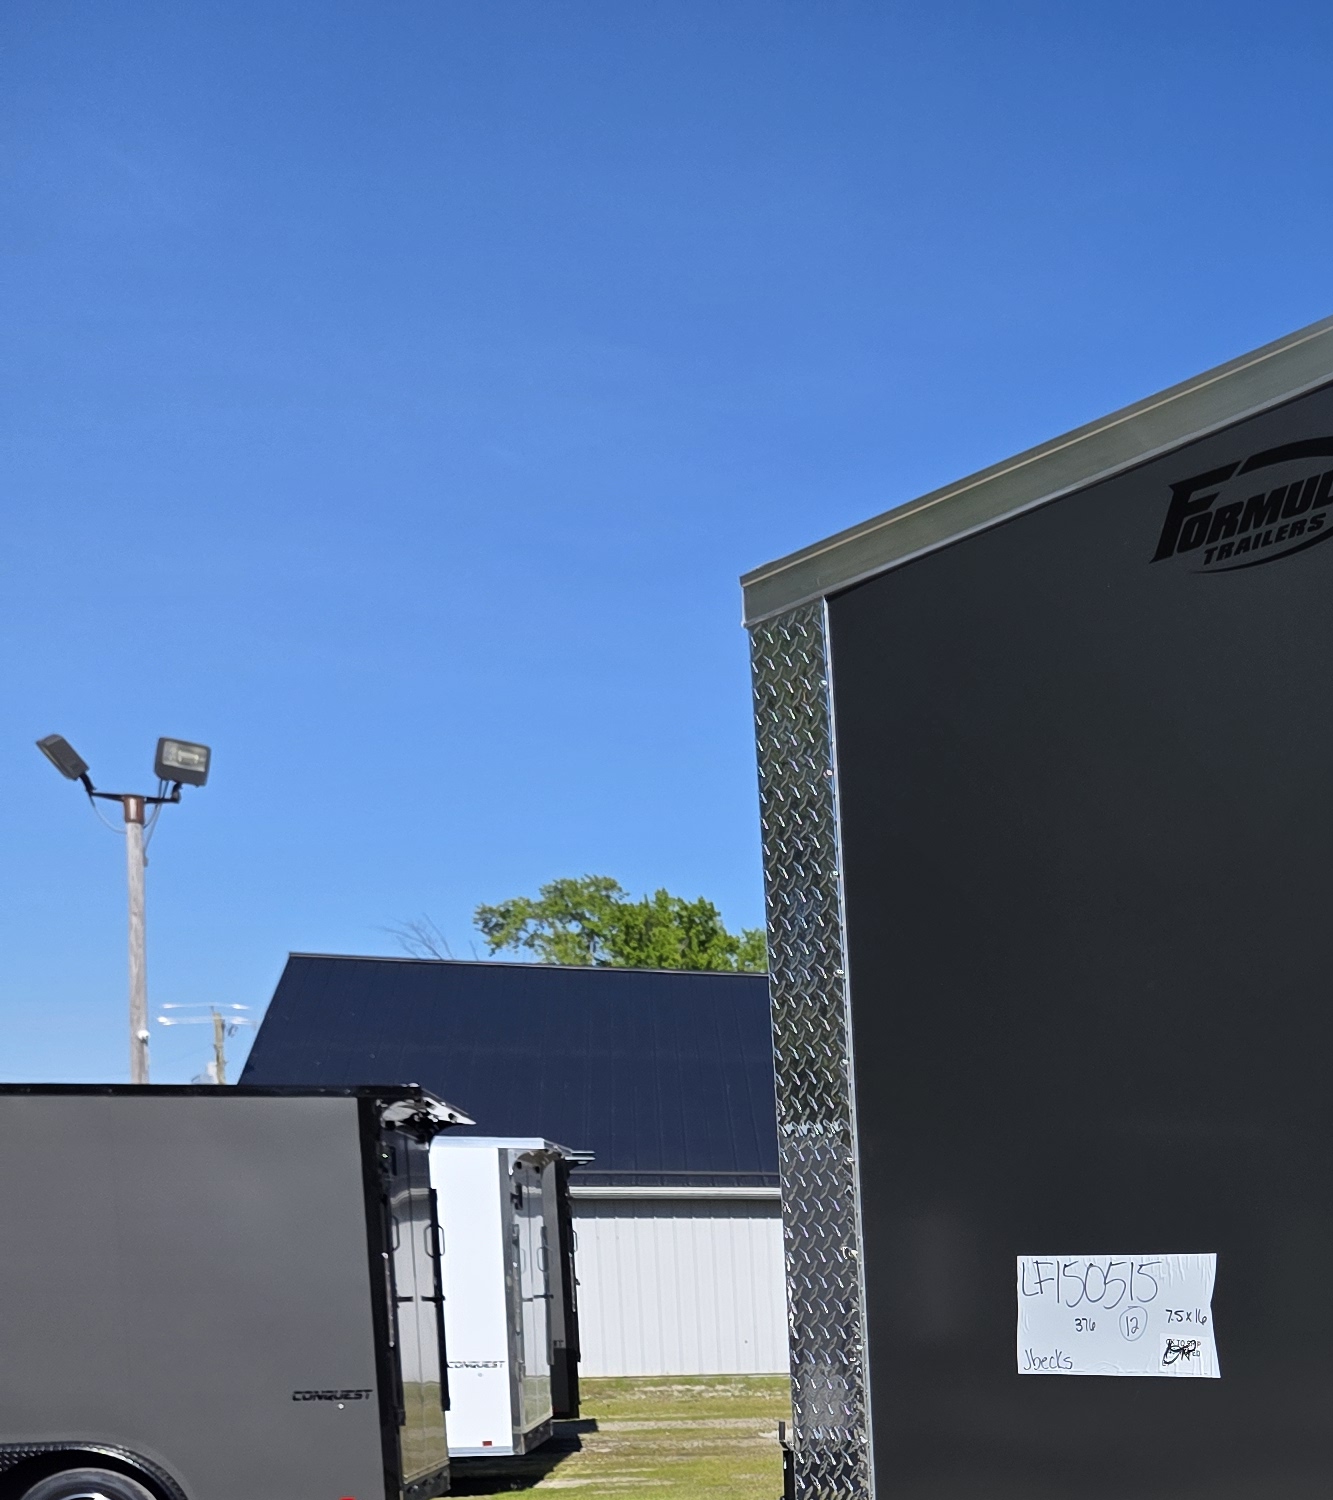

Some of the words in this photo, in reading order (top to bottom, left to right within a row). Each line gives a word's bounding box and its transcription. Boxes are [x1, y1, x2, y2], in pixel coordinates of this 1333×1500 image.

[1203, 512, 1327, 565] TRAILERS
[1125, 1315, 1139, 1337] 12
[292, 1389, 373, 1401] CONQUEST
